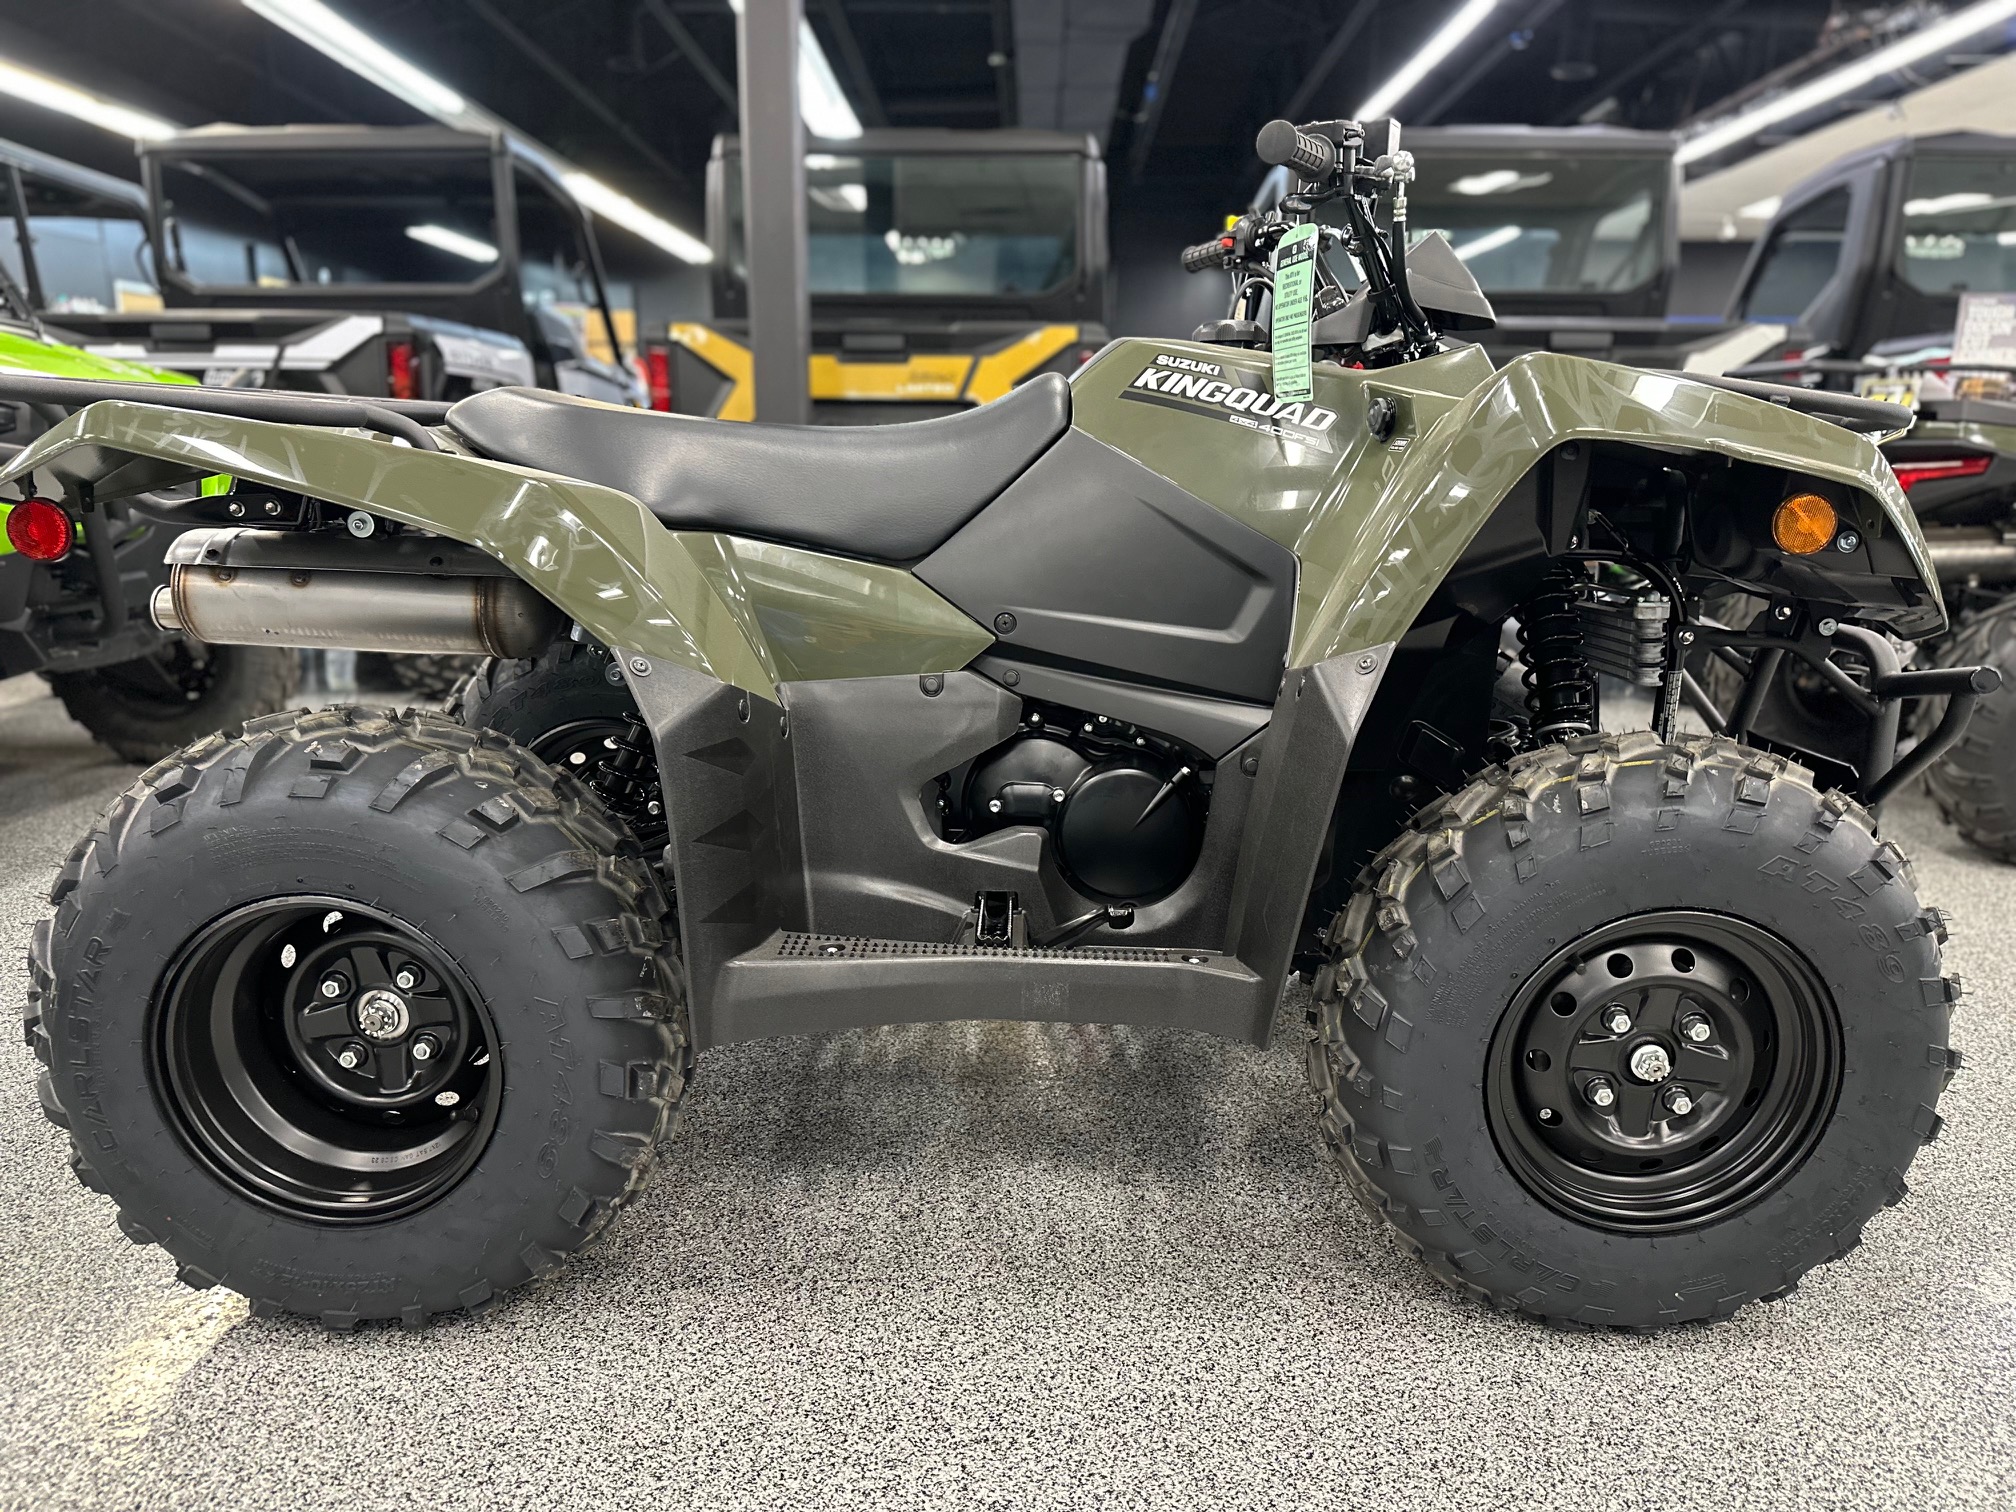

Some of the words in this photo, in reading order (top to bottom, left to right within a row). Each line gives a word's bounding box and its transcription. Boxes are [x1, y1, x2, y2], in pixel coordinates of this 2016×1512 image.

[1134, 368, 1339, 431] KINGQUAD
[1156, 355, 1221, 375] SUZUKI
[1757, 854, 1905, 983] AT489
[64, 936, 118, 1154] CARLSTAR
[532, 995, 574, 1179] AT489
[1429, 1166, 1581, 1293] CARLSTAR
